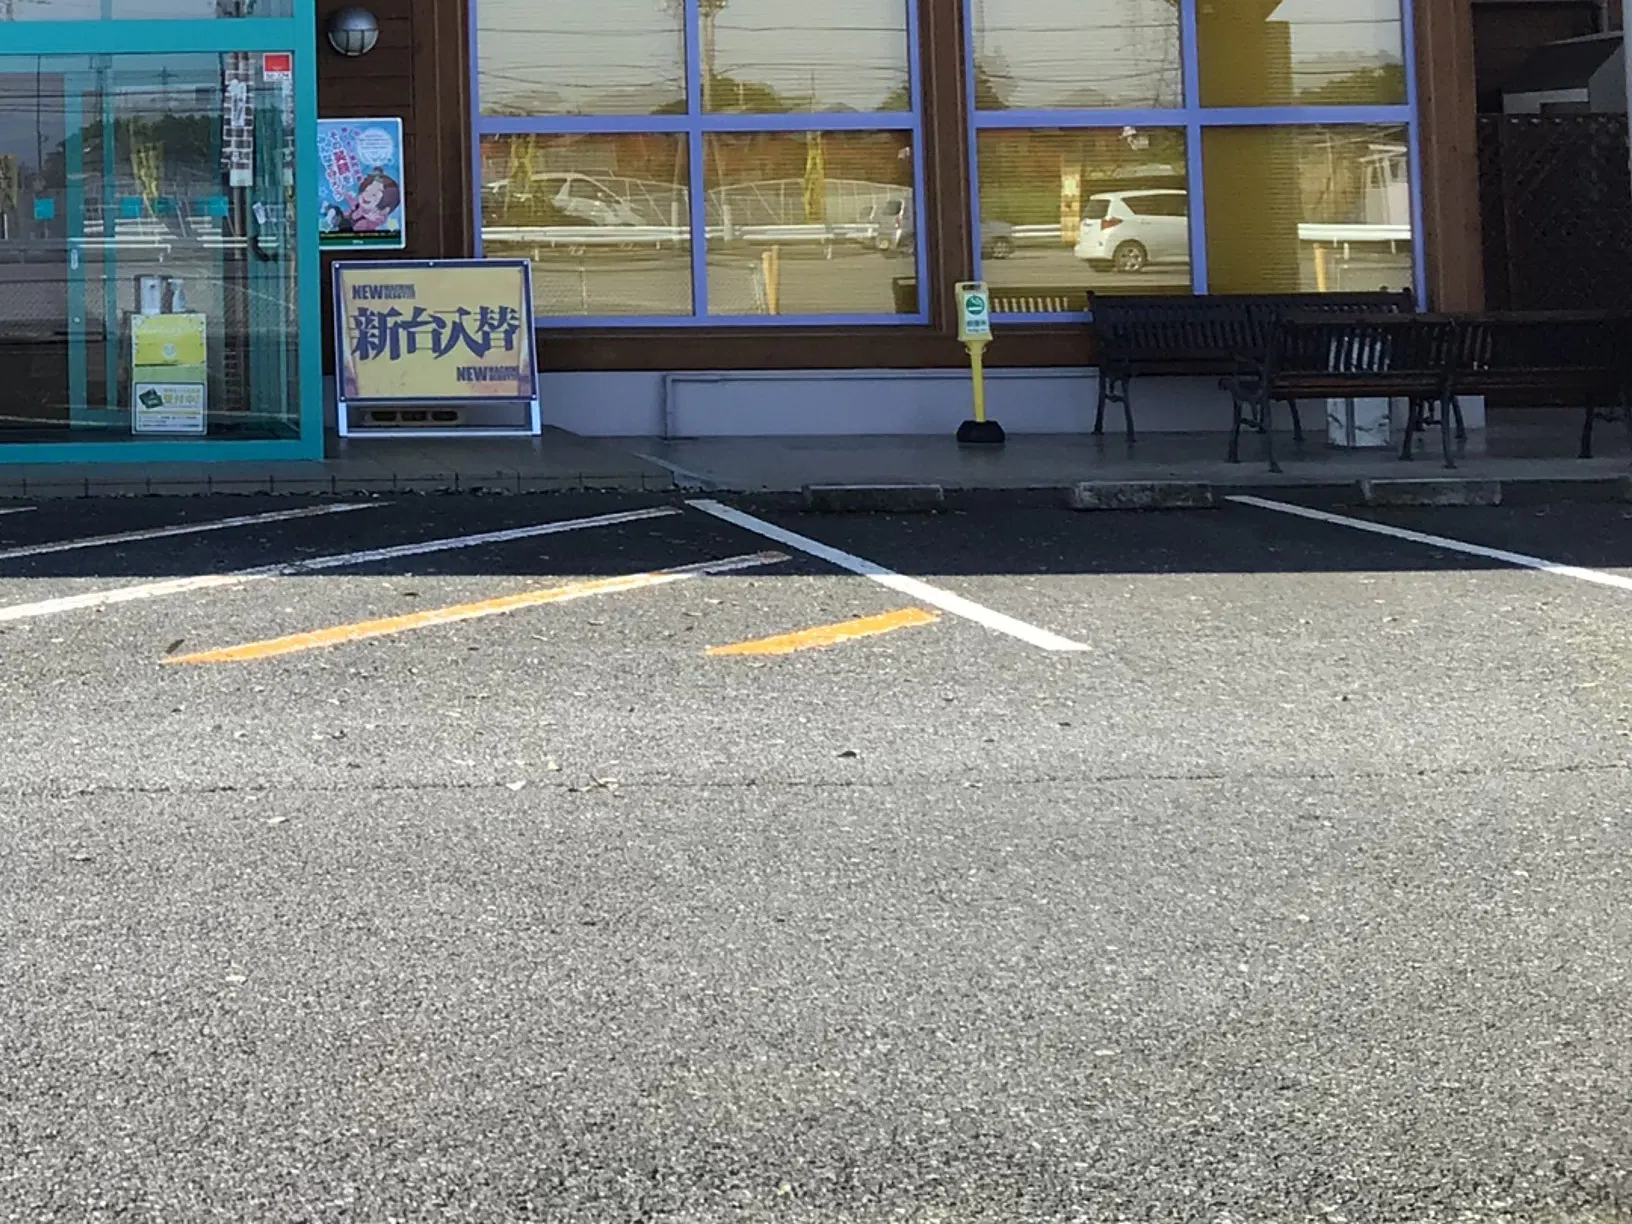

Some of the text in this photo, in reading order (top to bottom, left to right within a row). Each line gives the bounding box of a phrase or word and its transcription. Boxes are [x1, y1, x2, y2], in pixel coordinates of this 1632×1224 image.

[352, 284, 383, 300] NEW
[350, 306, 520, 361] 新台入替
[456, 366, 489, 382] NEW
